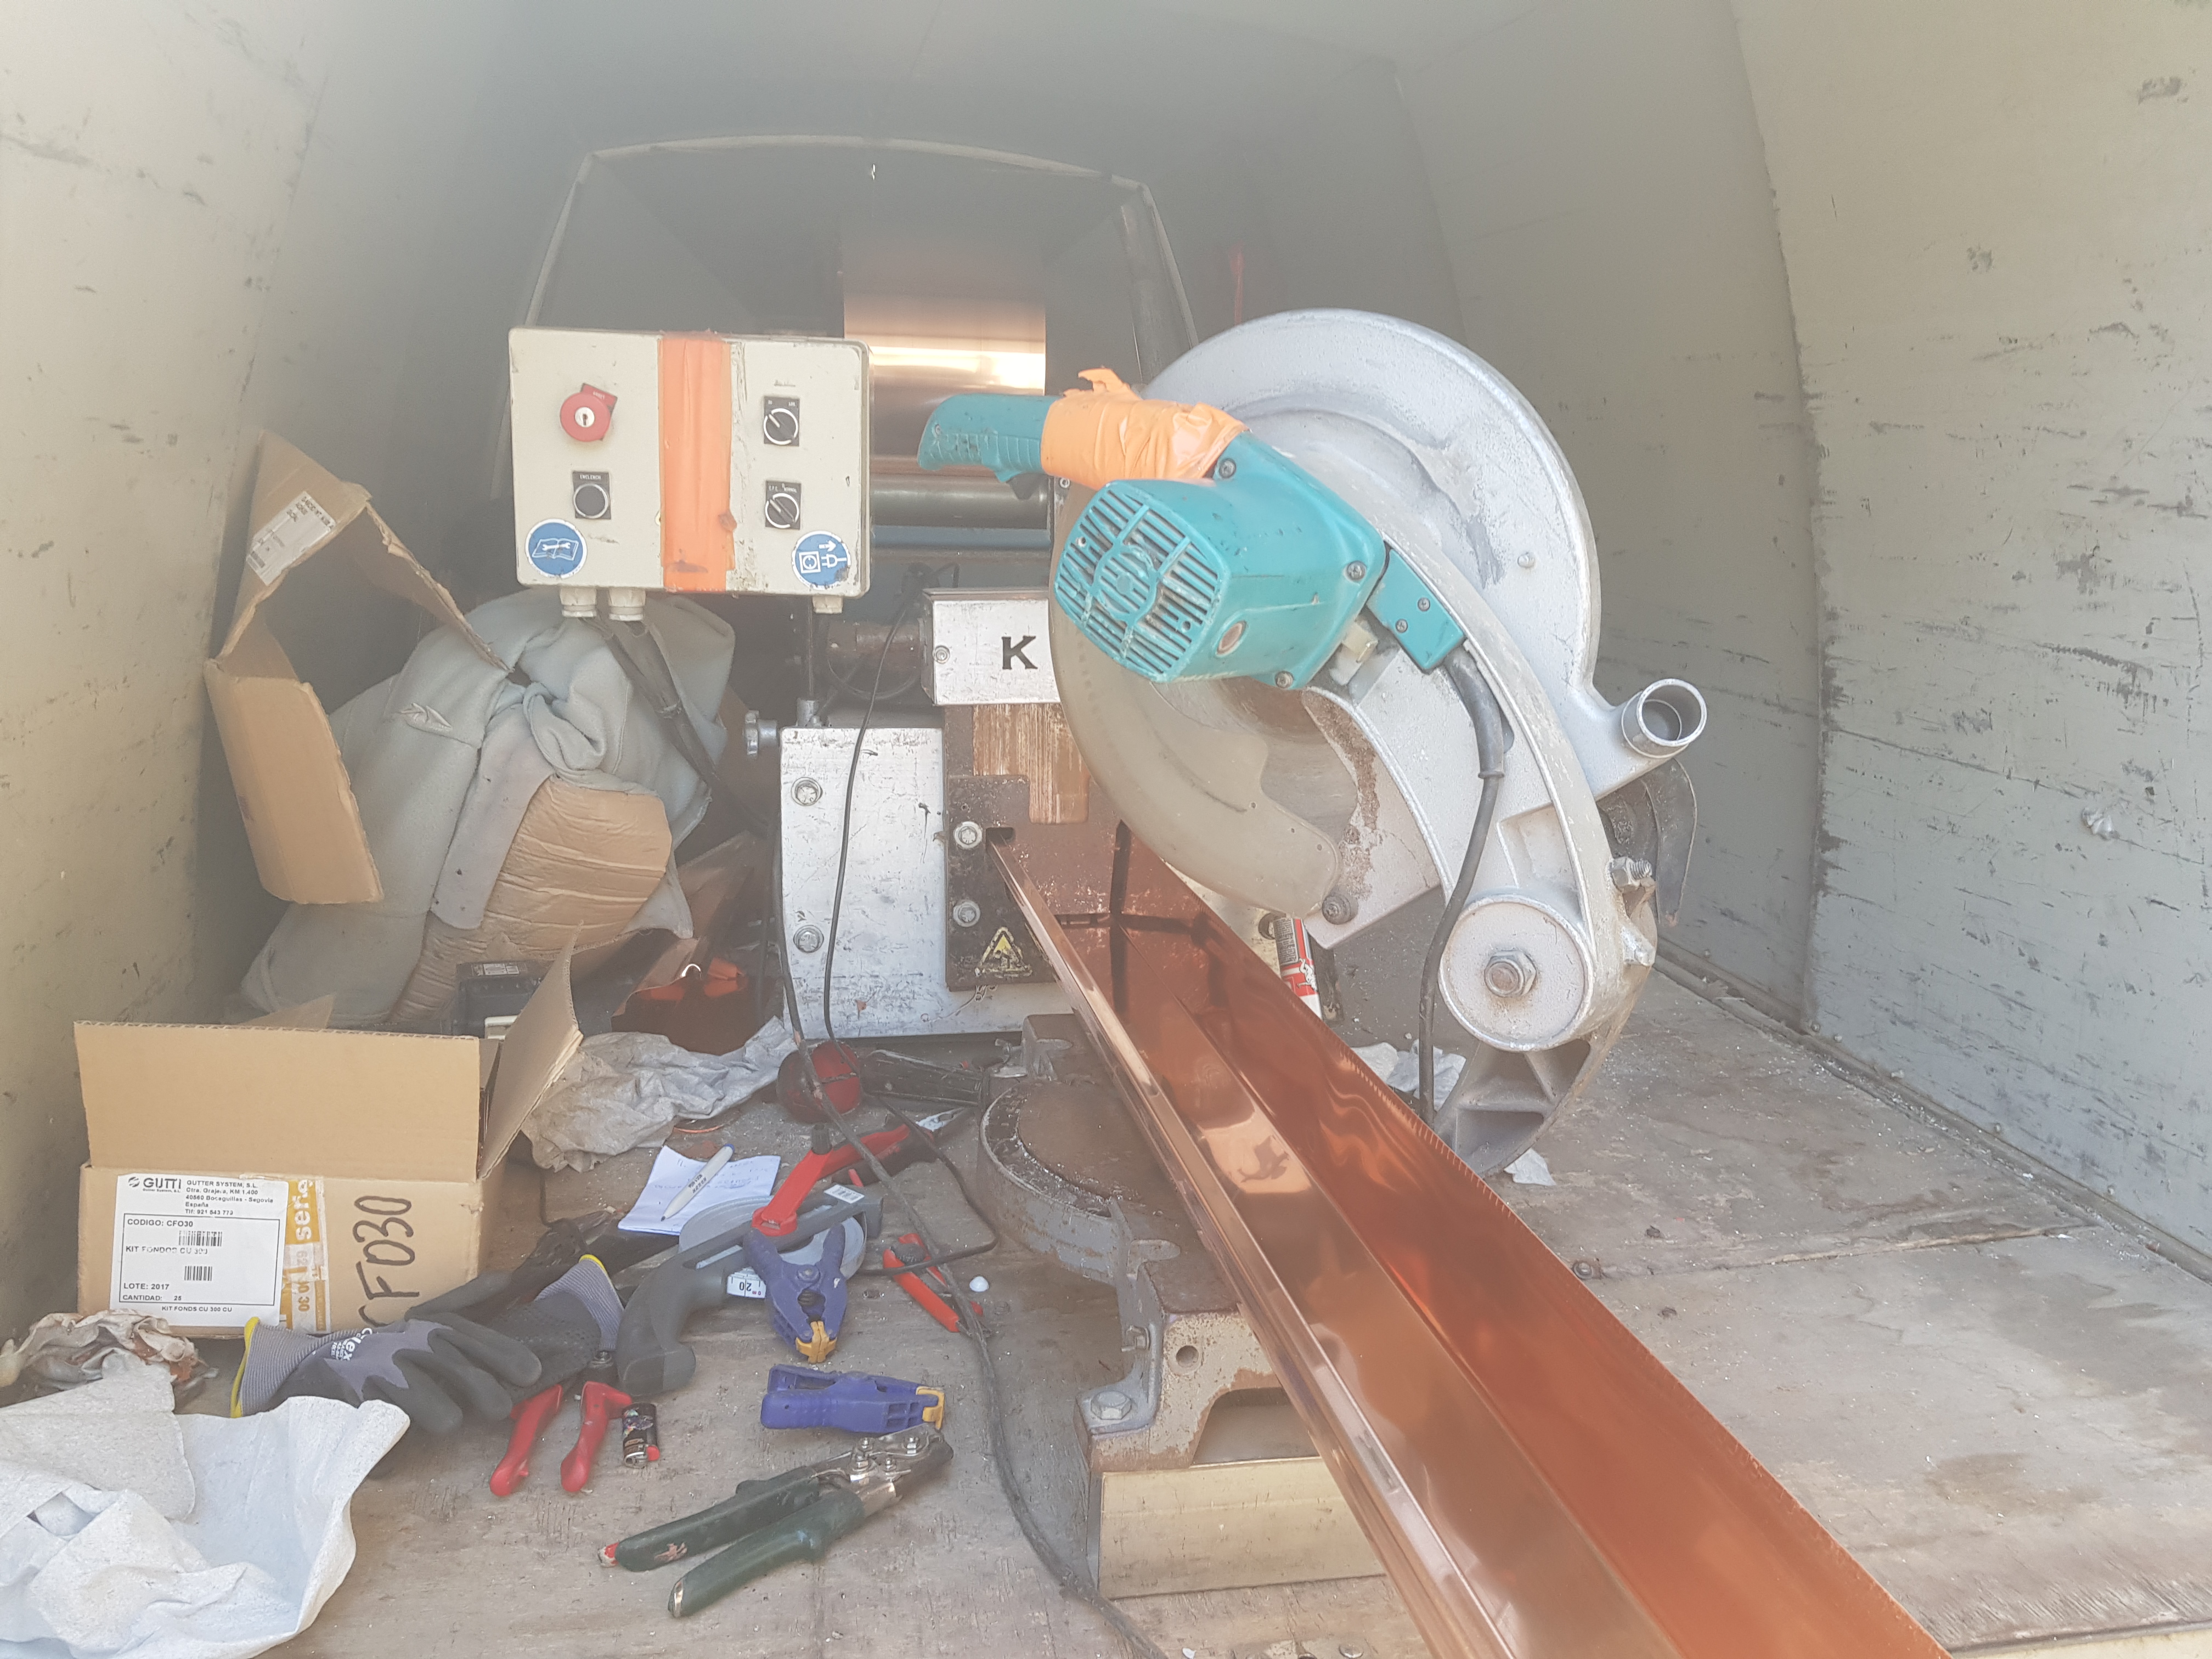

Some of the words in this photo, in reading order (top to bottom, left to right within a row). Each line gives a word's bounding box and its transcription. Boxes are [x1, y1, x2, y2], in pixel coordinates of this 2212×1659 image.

[1001, 636, 1038, 669] K
[143, 1177, 182, 1189] GUTTI
[739, 1282, 752, 1291] 20
